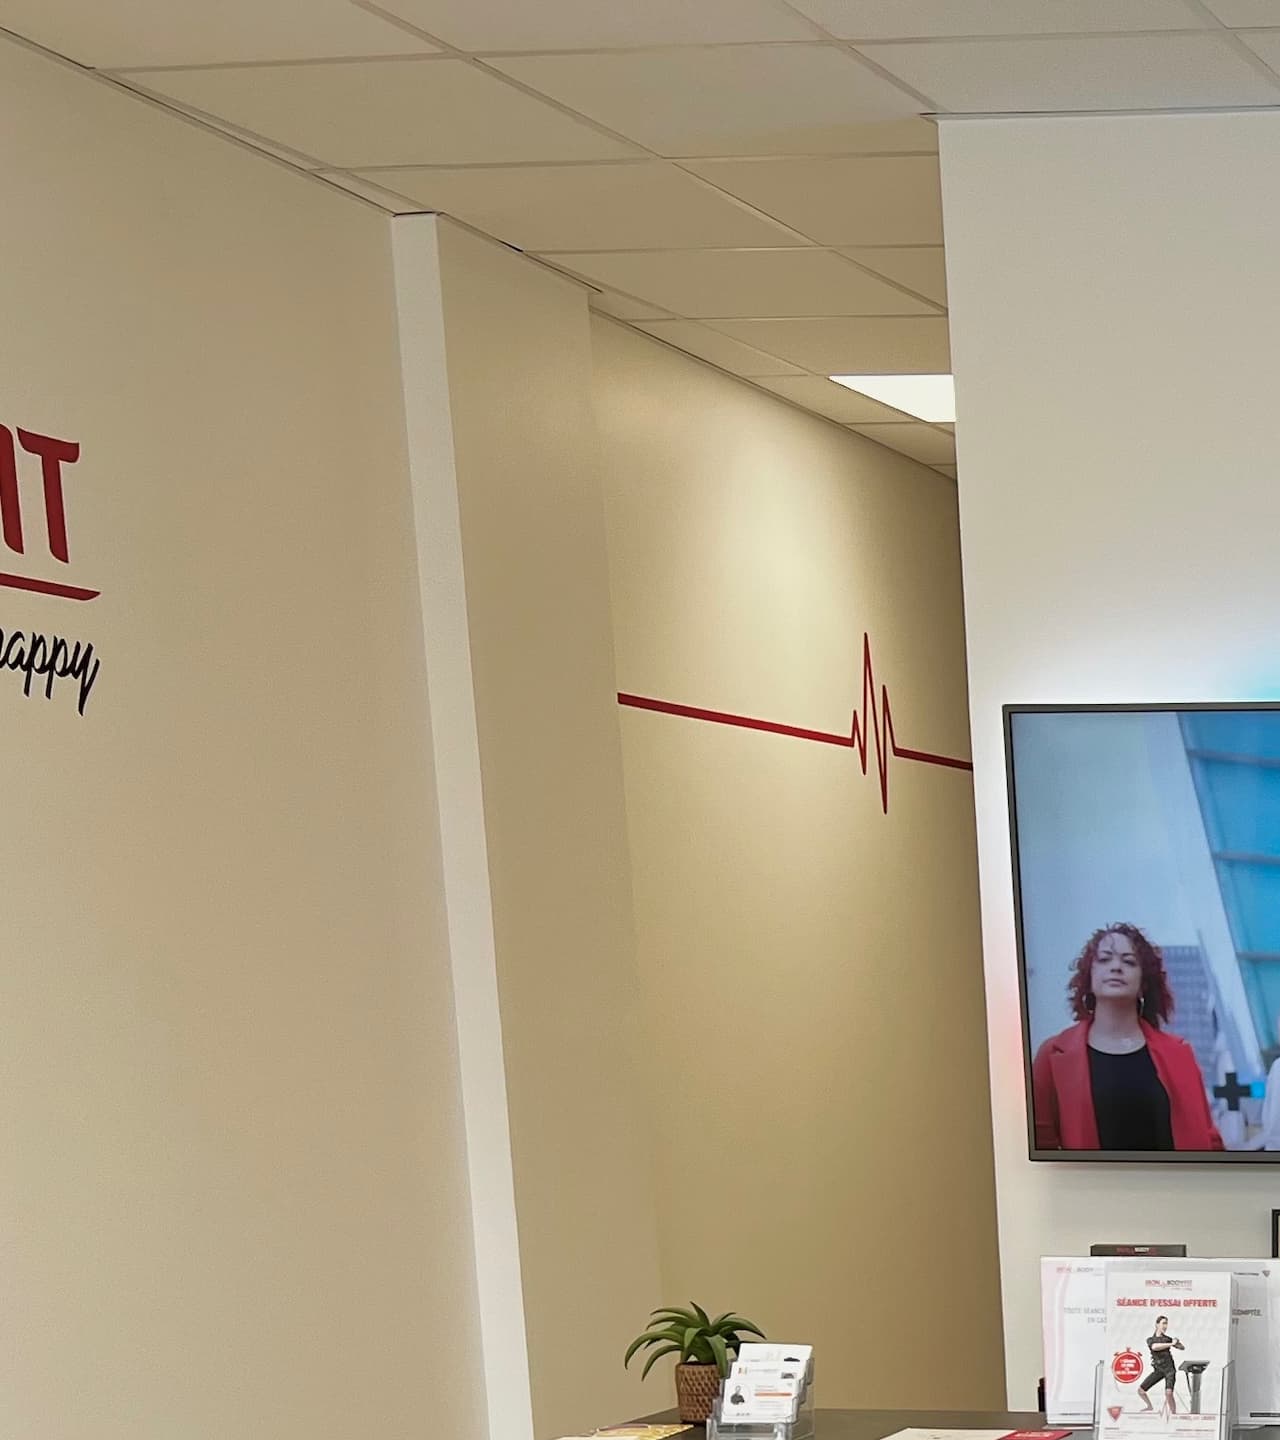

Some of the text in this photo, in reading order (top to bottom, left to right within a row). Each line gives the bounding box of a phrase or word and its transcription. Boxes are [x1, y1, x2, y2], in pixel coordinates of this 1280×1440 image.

[1116, 1297, 1217, 1307] SÉANCE D'ESSAI OFFERTE
